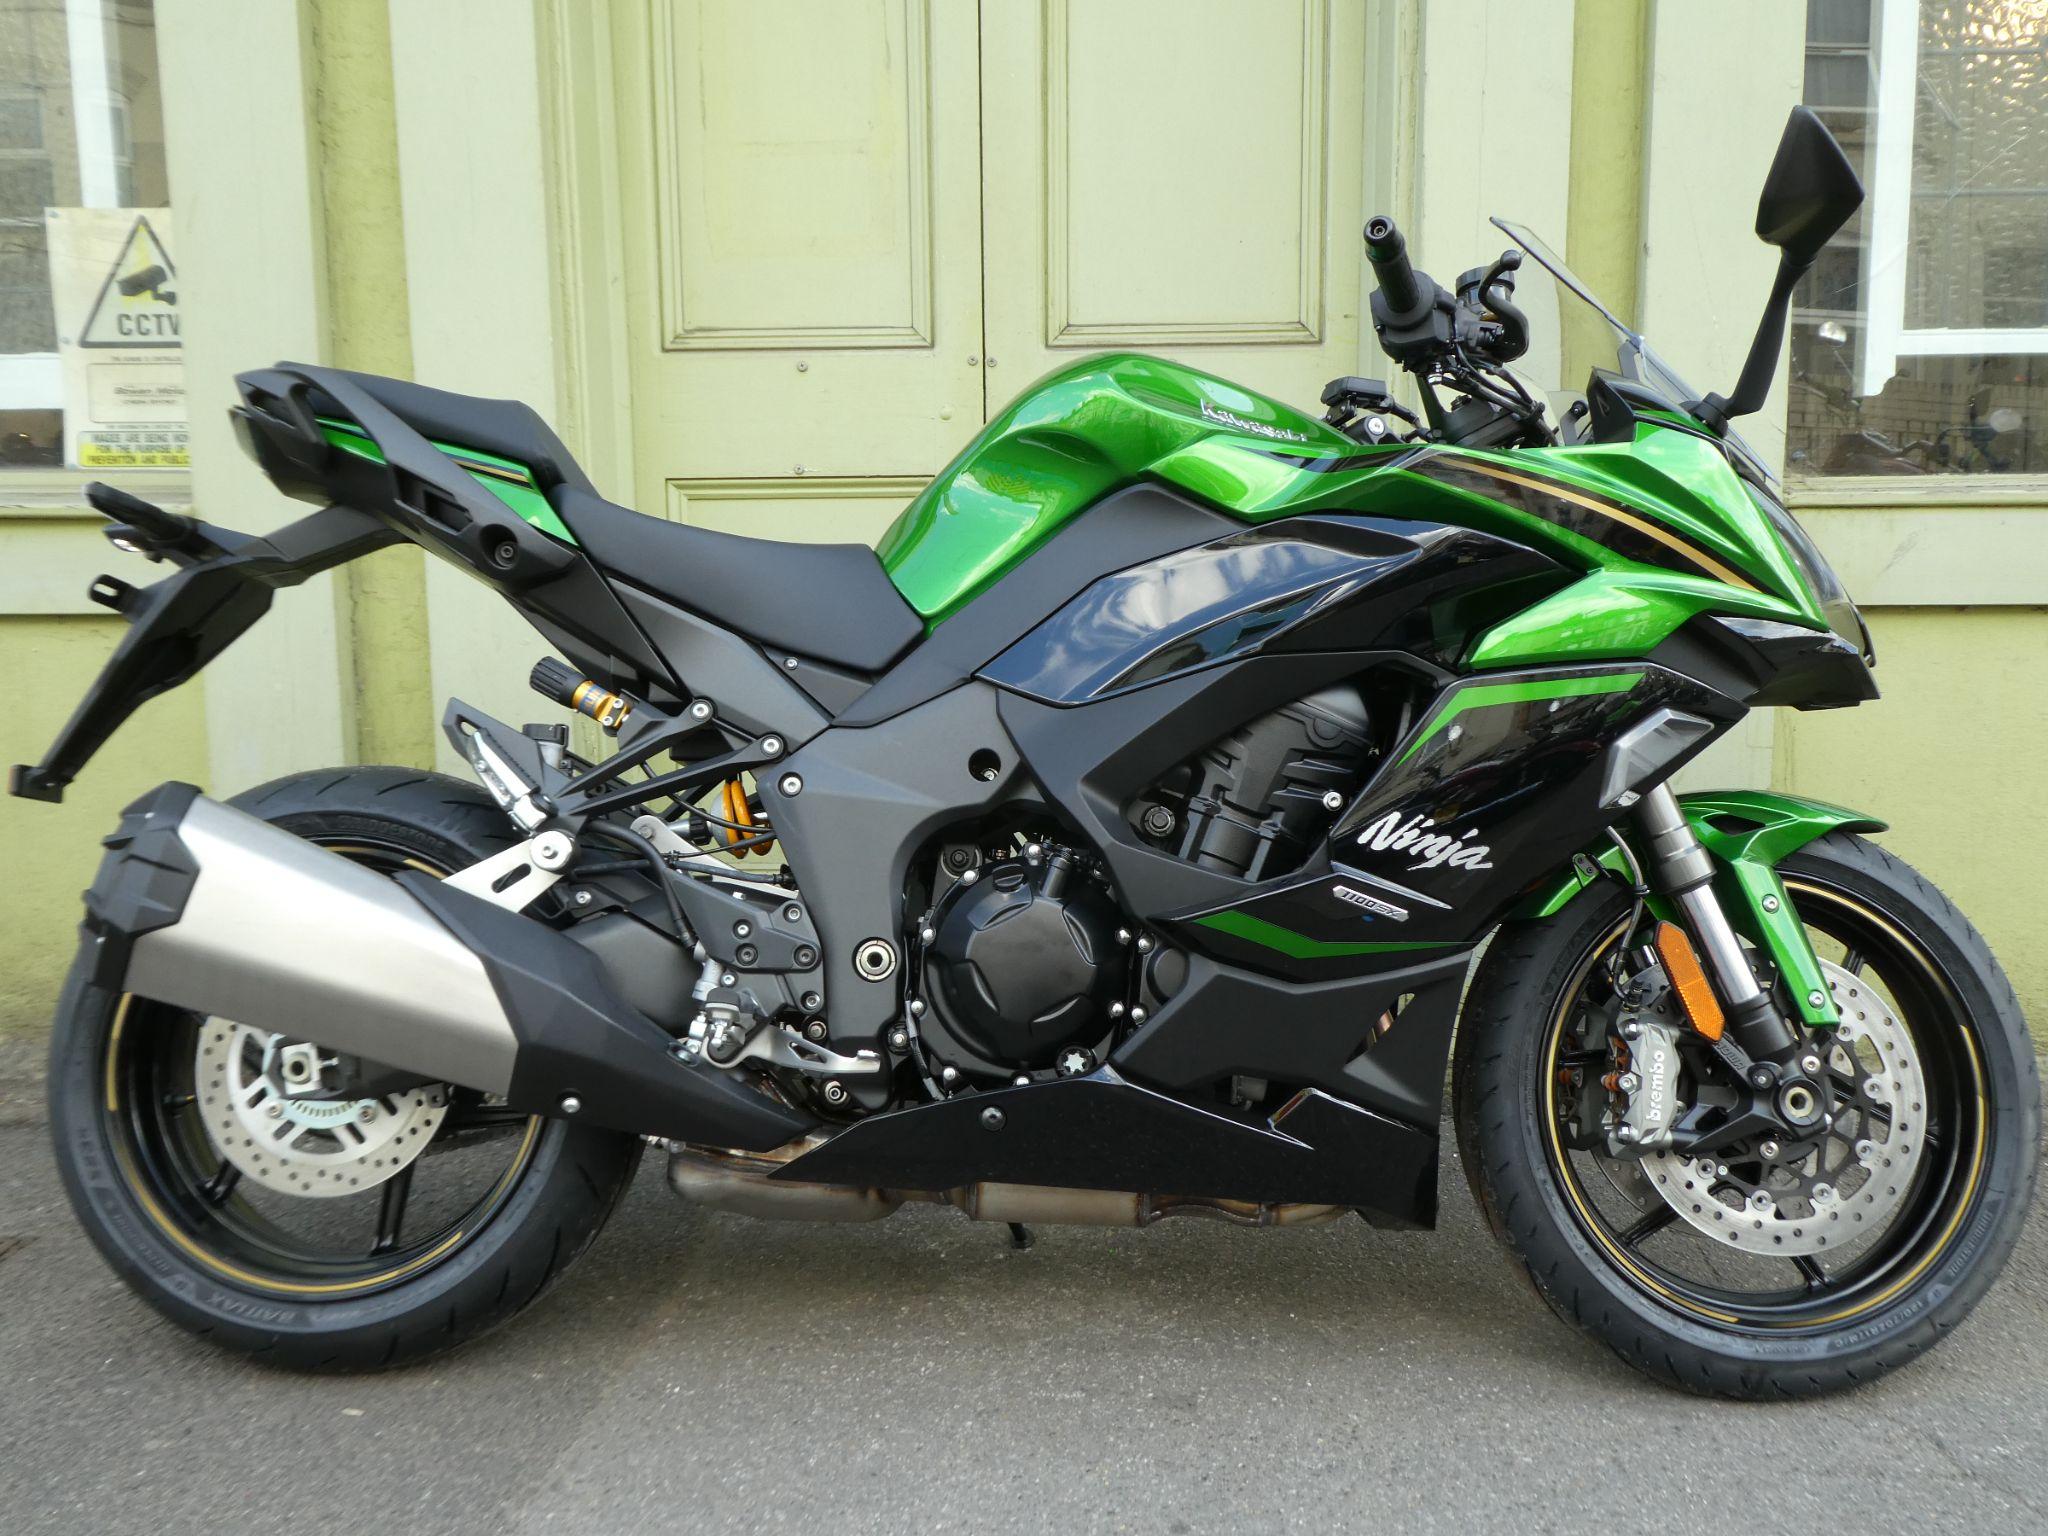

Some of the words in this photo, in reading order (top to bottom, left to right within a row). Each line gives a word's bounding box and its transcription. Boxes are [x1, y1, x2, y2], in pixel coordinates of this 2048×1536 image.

[117, 313, 179, 336] CCTV
[1357, 811, 1493, 871] Ninja
[1645, 1050, 1665, 1121] brembo
